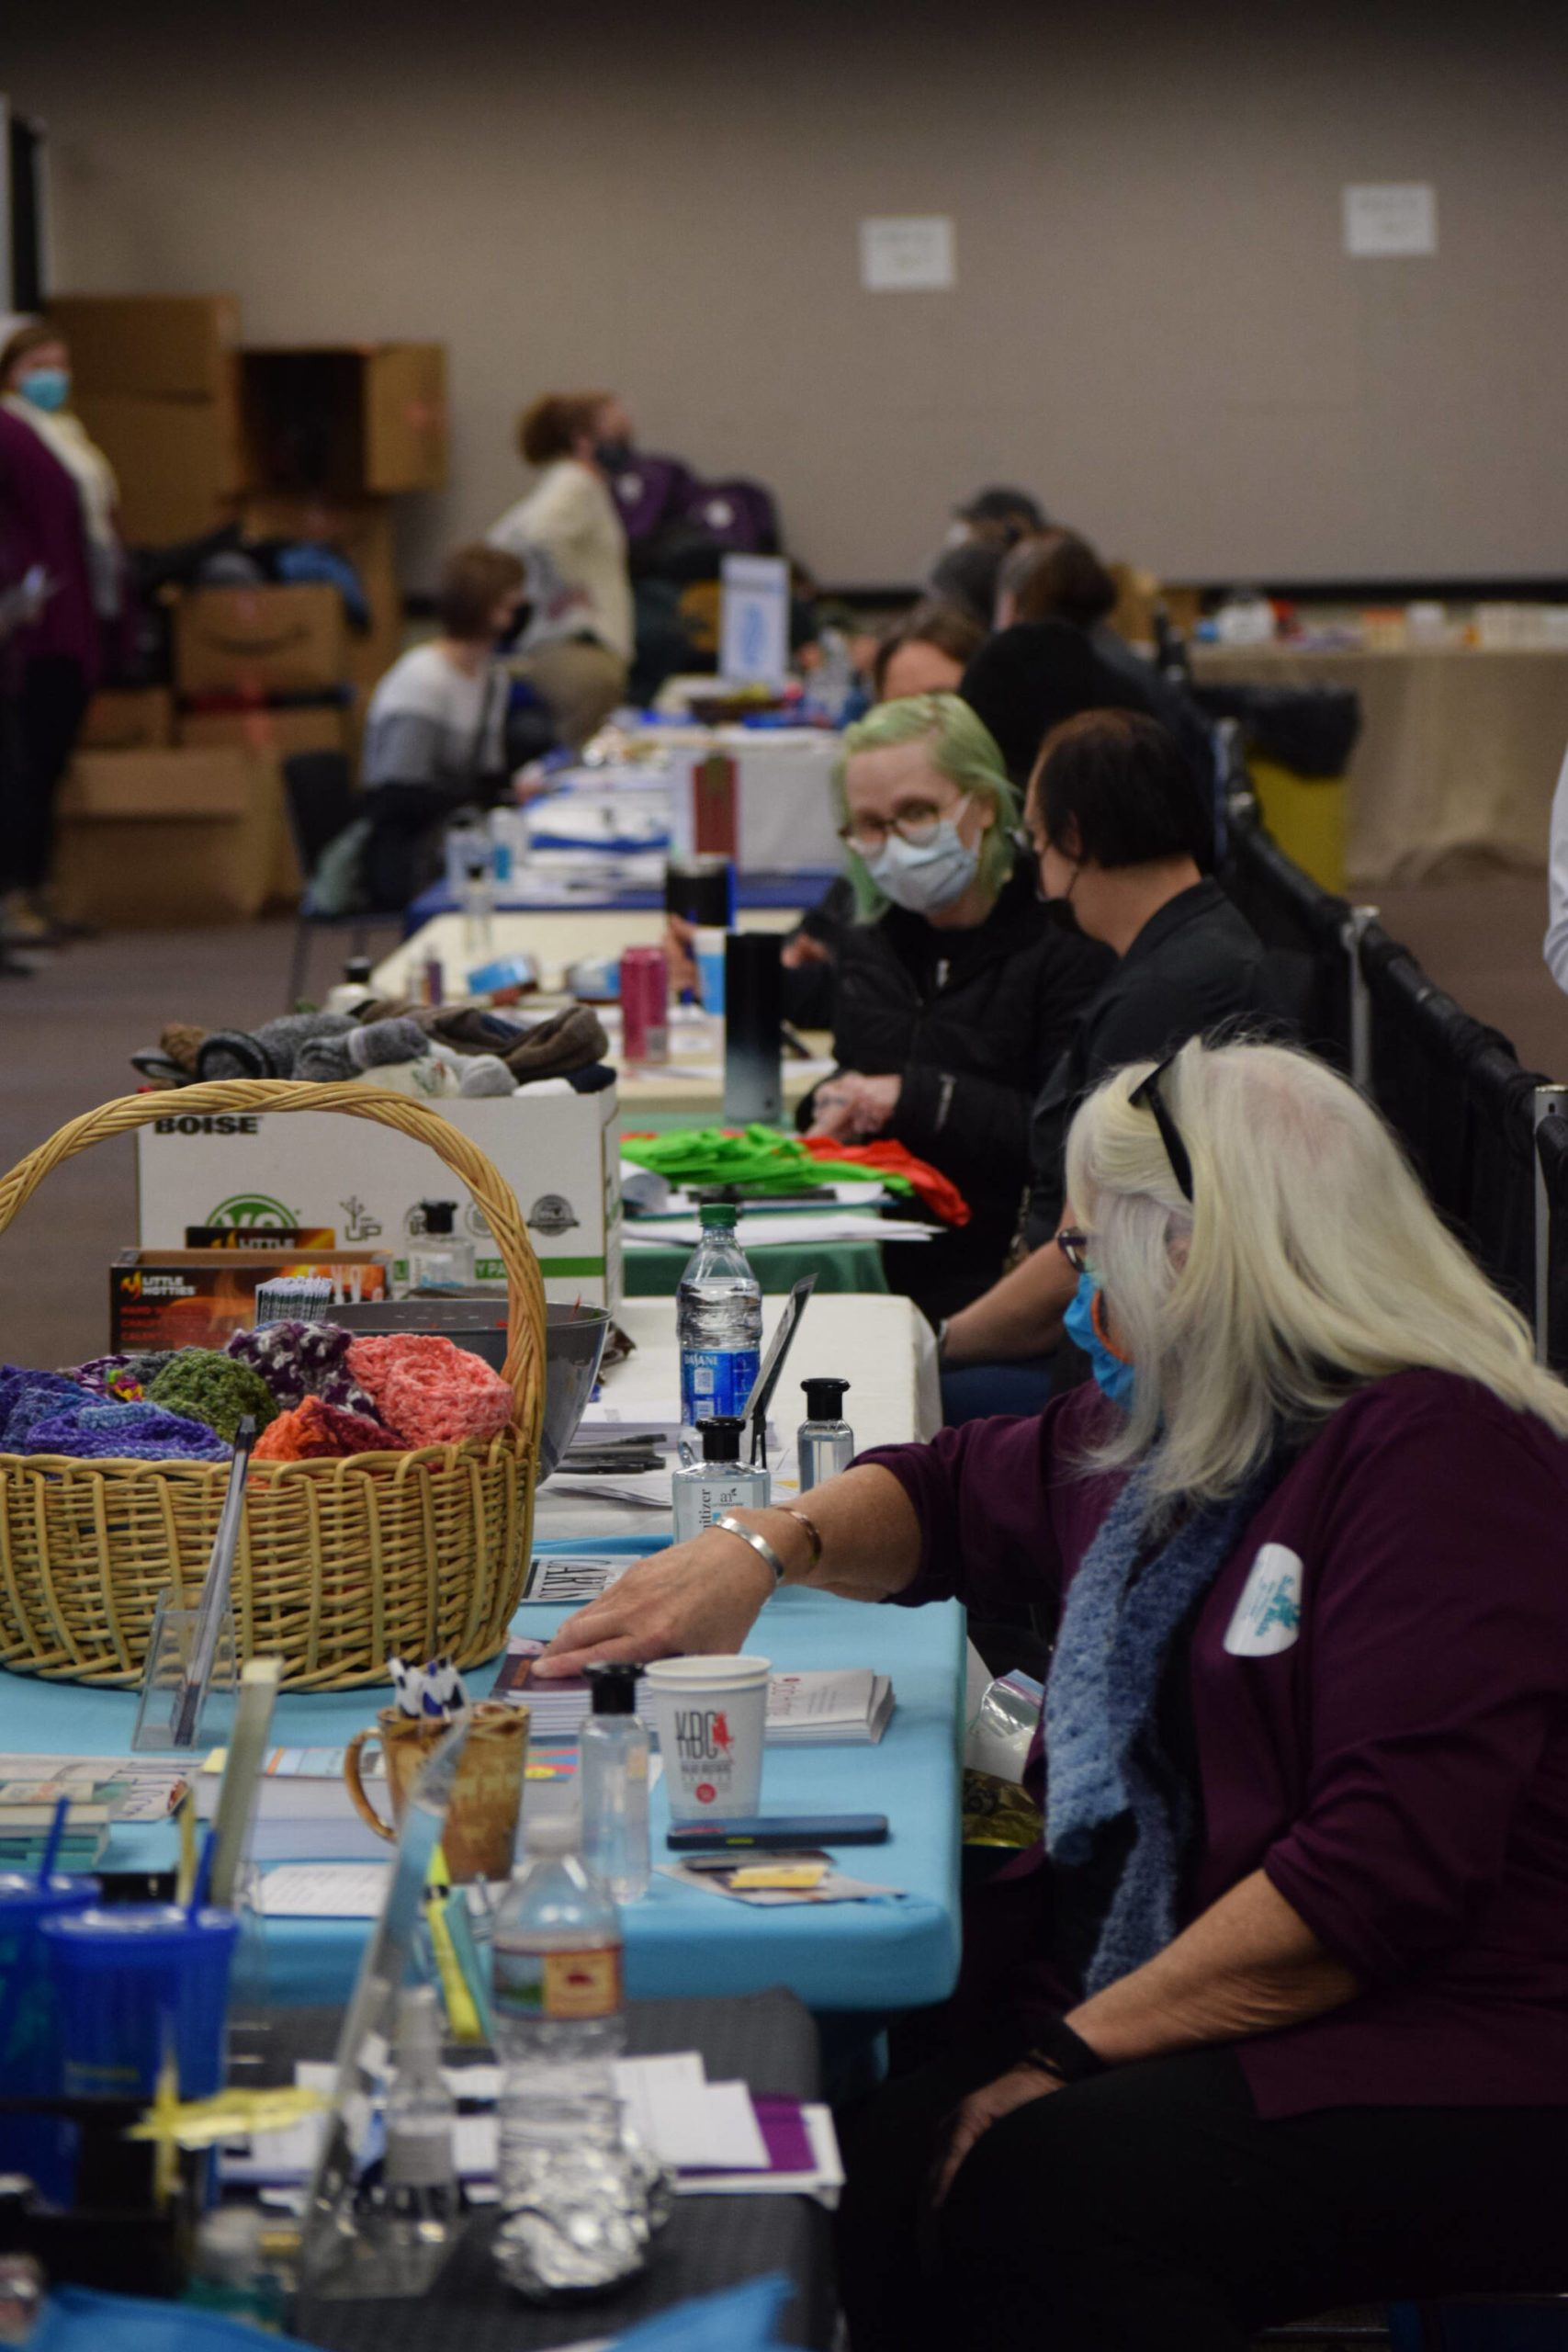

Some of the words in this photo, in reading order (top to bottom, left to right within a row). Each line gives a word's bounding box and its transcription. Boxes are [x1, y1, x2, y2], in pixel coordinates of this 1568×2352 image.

[154, 1115, 259, 1135] BOISE
[142, 1276, 184, 1285] LITTLE
[142, 1286, 196, 1296] HOTTIES
